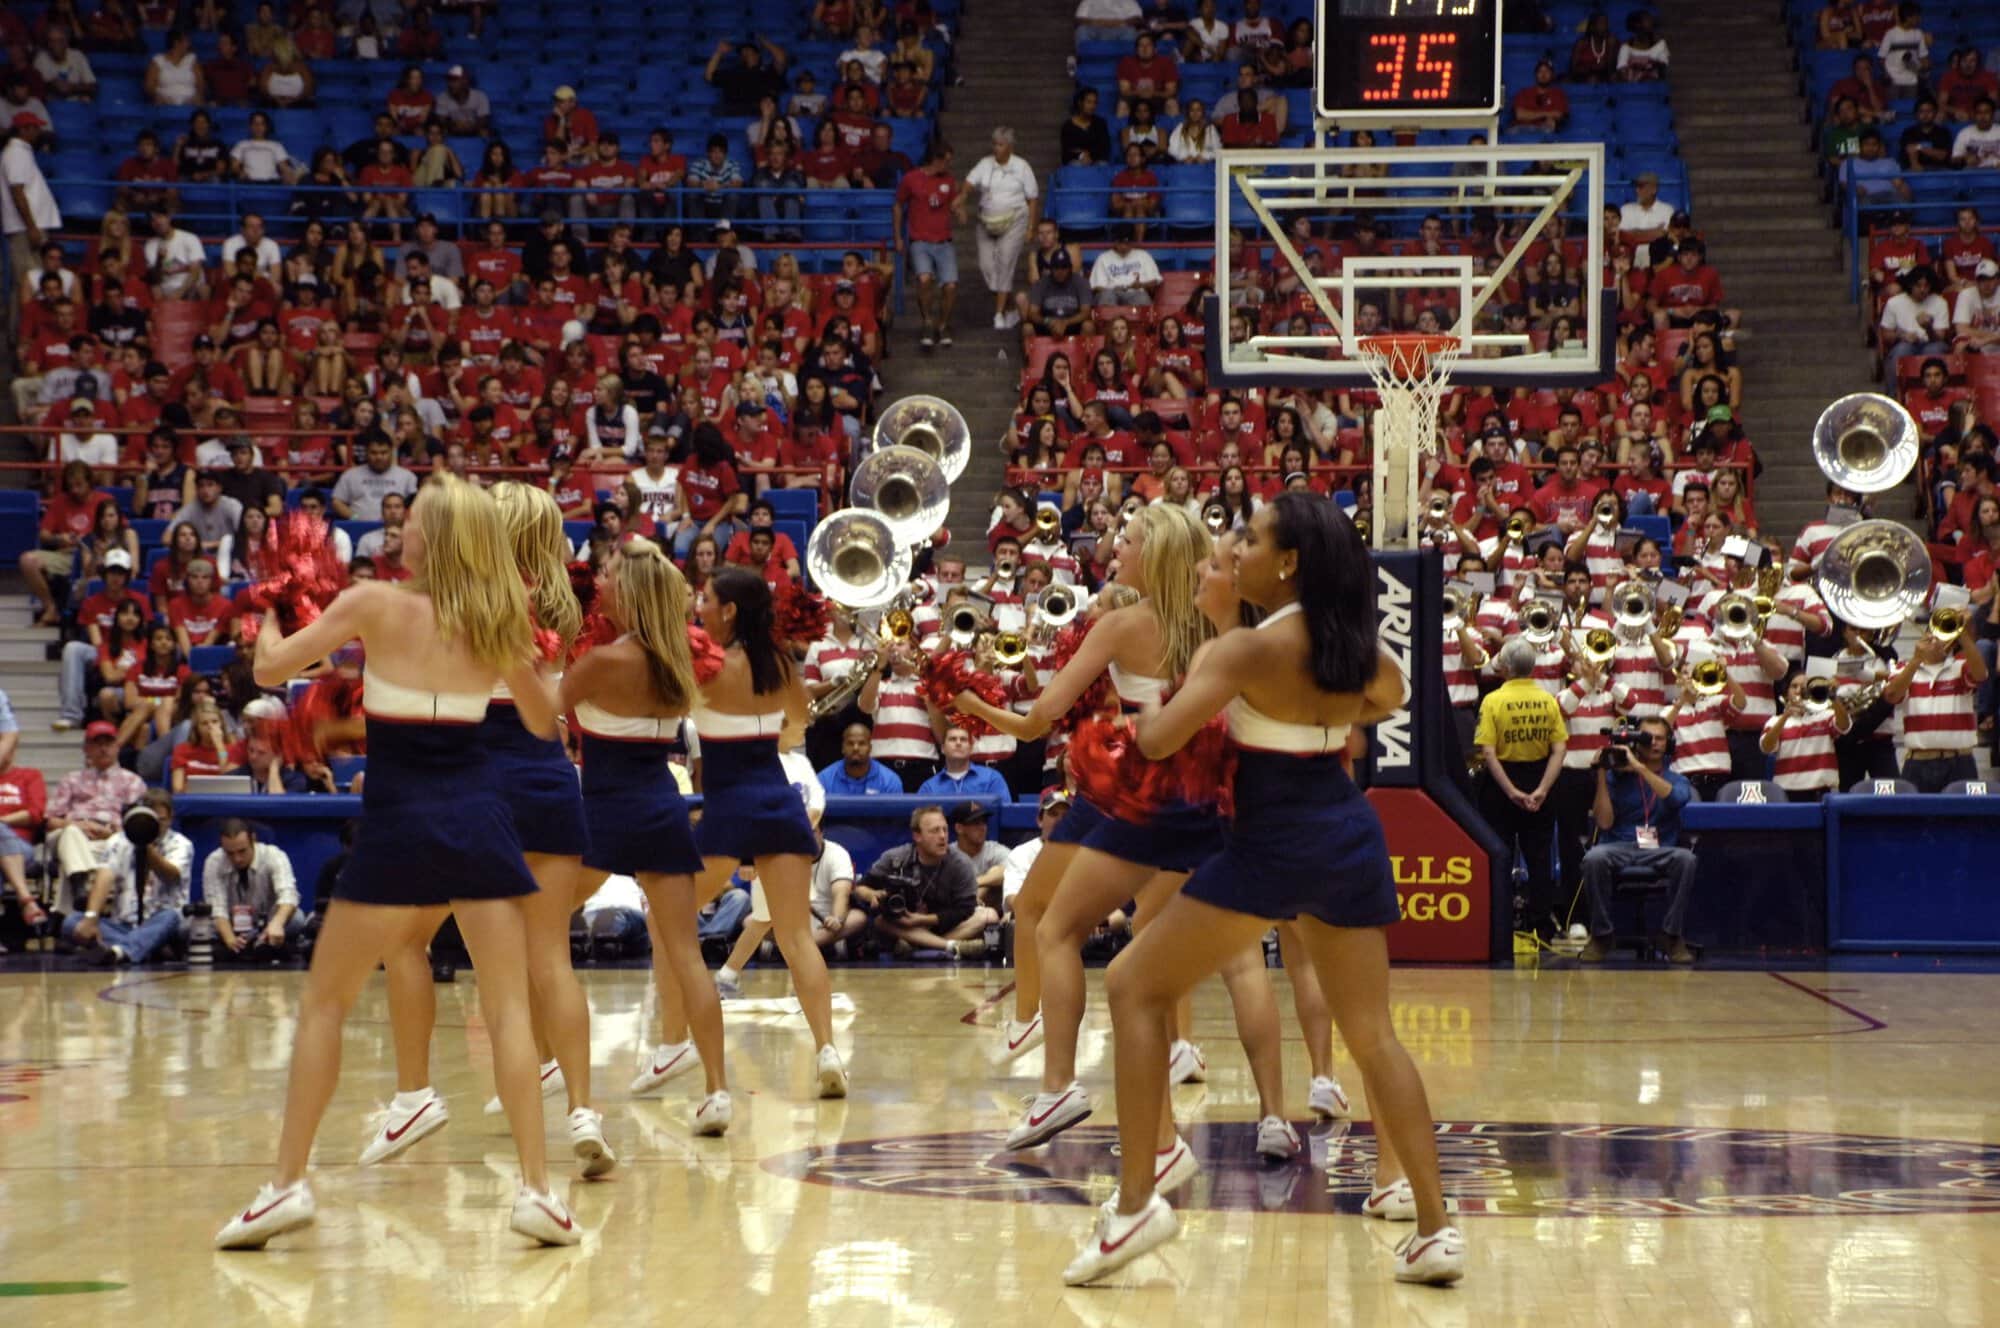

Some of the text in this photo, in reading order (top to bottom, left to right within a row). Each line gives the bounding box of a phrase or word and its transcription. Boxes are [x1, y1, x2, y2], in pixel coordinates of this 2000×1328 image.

[1363, 33, 1457, 101] 35
[1506, 701, 1549, 711] EVENT
[1504, 727, 1553, 744] SECURITY
[1389, 856, 1473, 885] LLS
